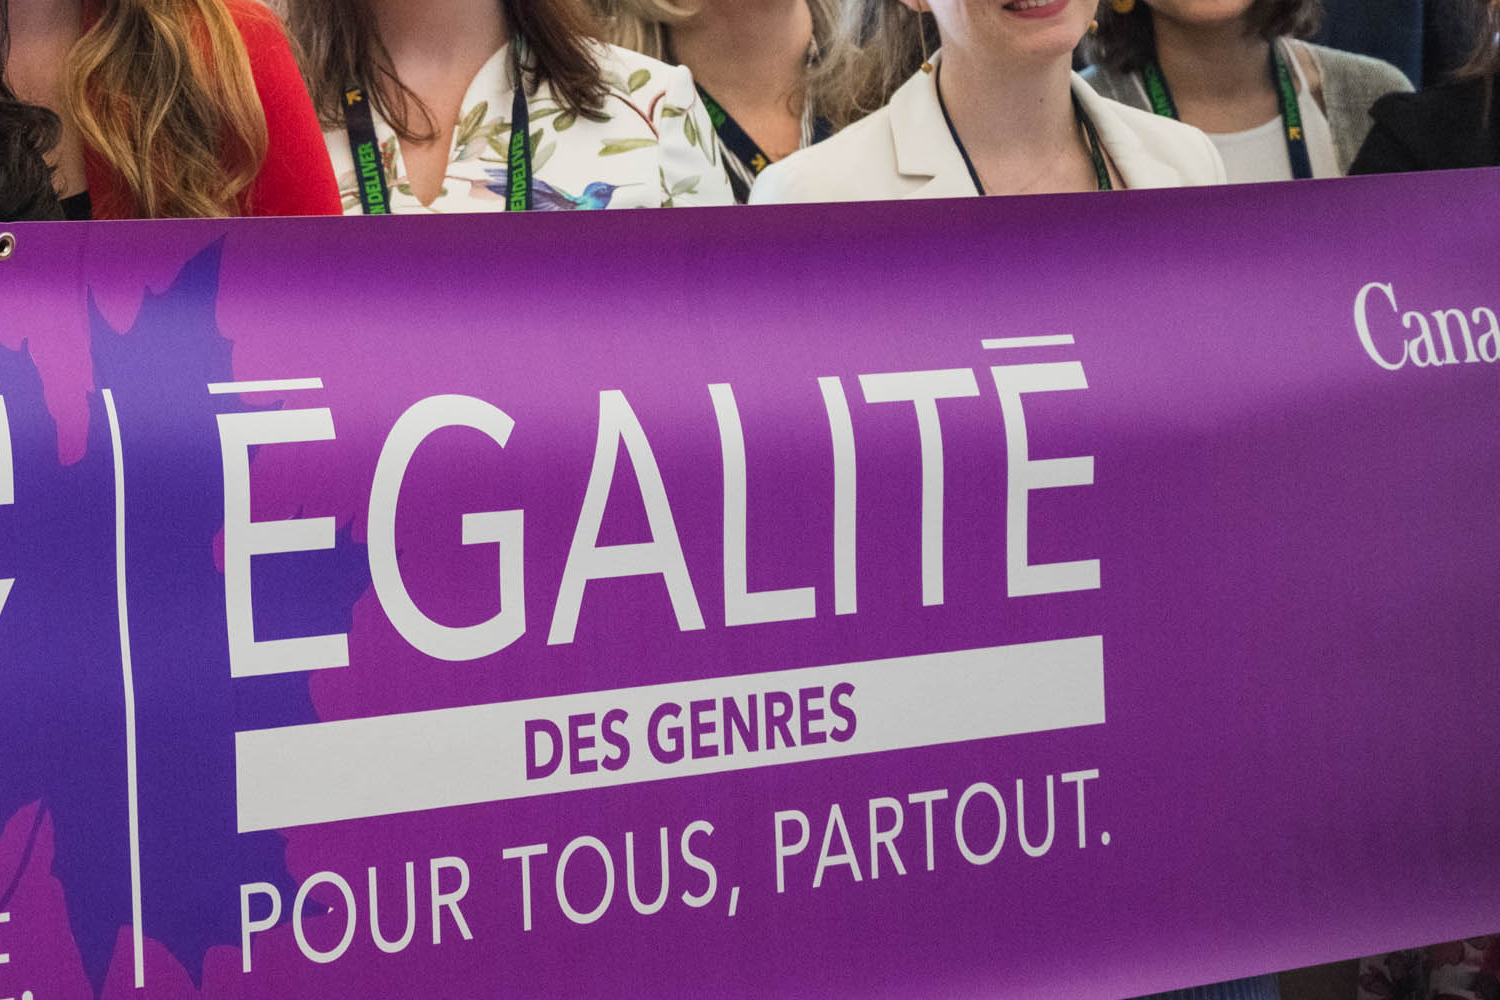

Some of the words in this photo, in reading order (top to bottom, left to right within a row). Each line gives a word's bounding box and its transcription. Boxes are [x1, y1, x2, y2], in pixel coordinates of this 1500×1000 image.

[357, 141, 384, 205] DELIVER
[1353, 281, 1500, 371] Cana
[524, 708, 631, 781] DES
[647, 681, 857, 765] GENRES
[238, 855, 474, 973] POUR
[502, 819, 741, 932] TOUS,
[773, 768, 1112, 895] PARTOUT.
